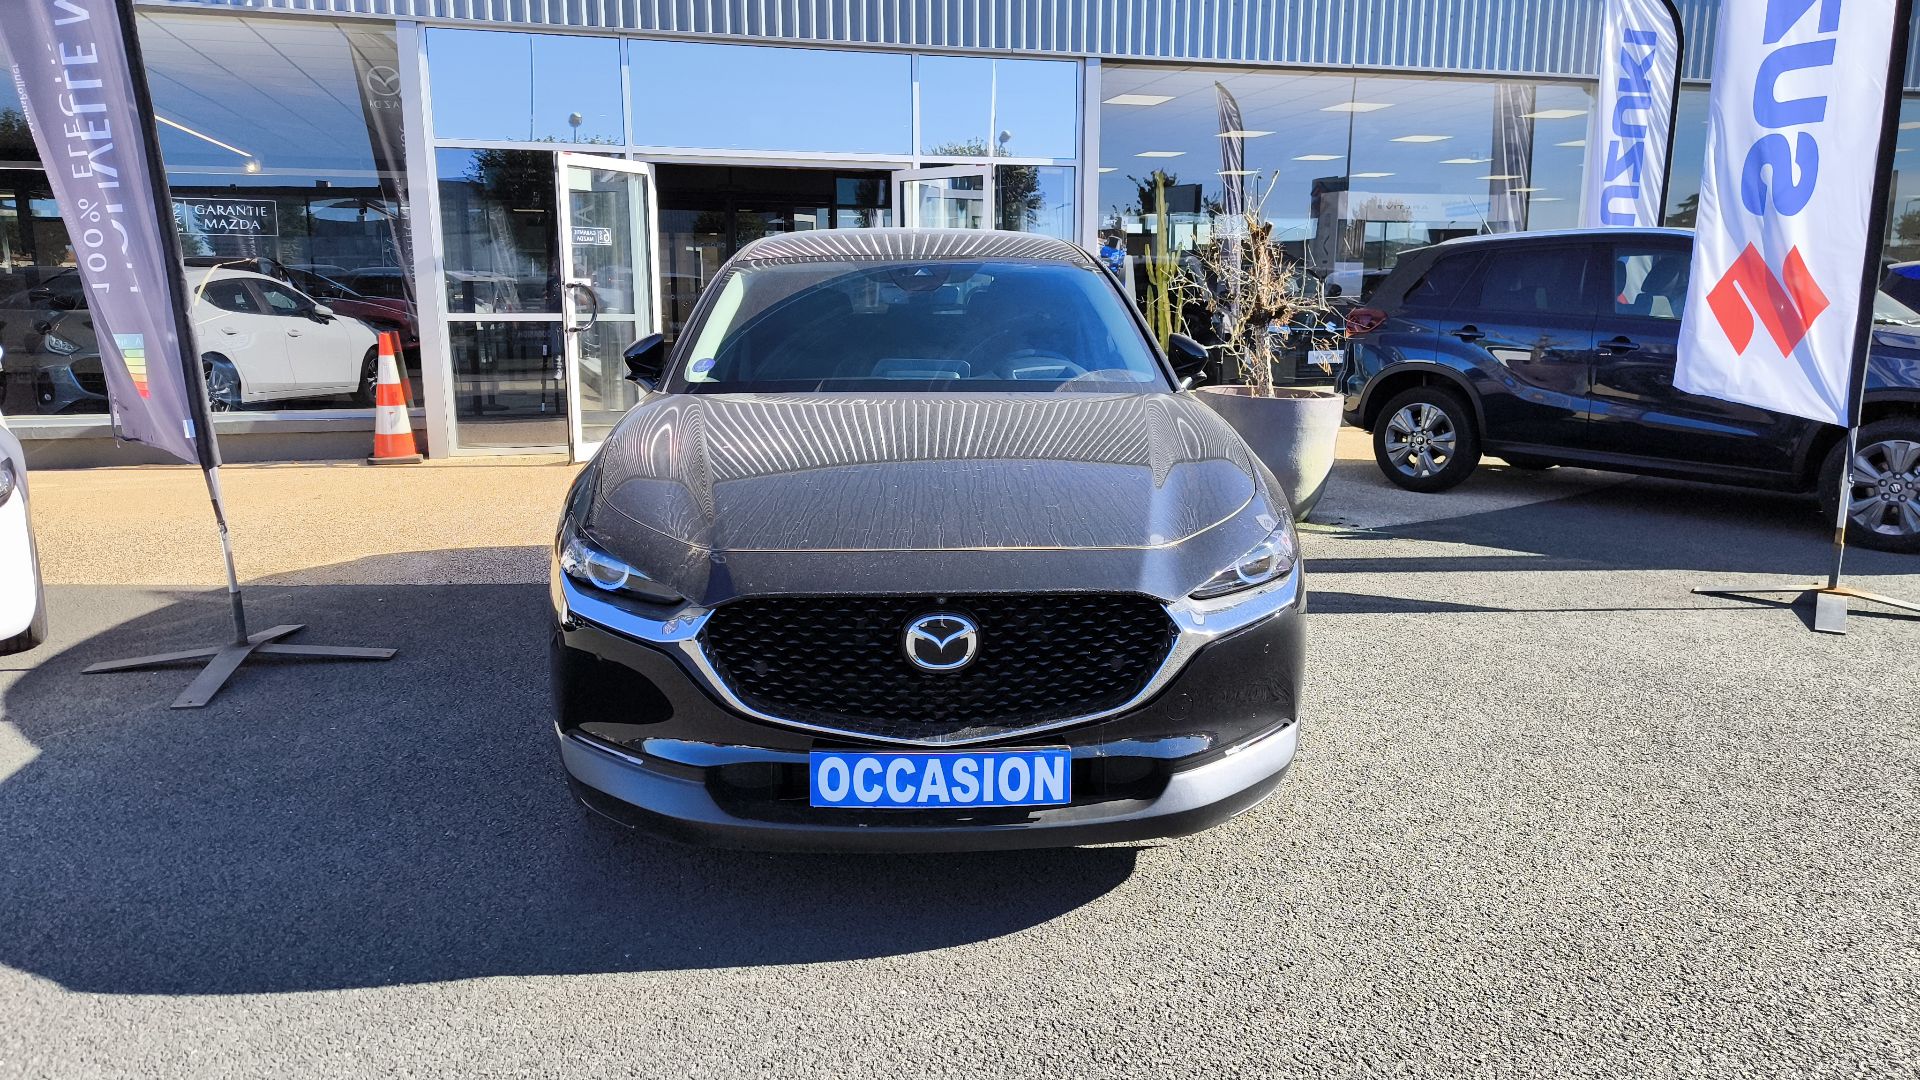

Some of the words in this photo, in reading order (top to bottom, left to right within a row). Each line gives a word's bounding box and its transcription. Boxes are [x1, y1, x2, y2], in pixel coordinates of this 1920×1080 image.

[194, 203, 268, 217] GARANTIE
[203, 218, 261, 231] MAZDA
[817, 756, 1065, 803] OCCASION
